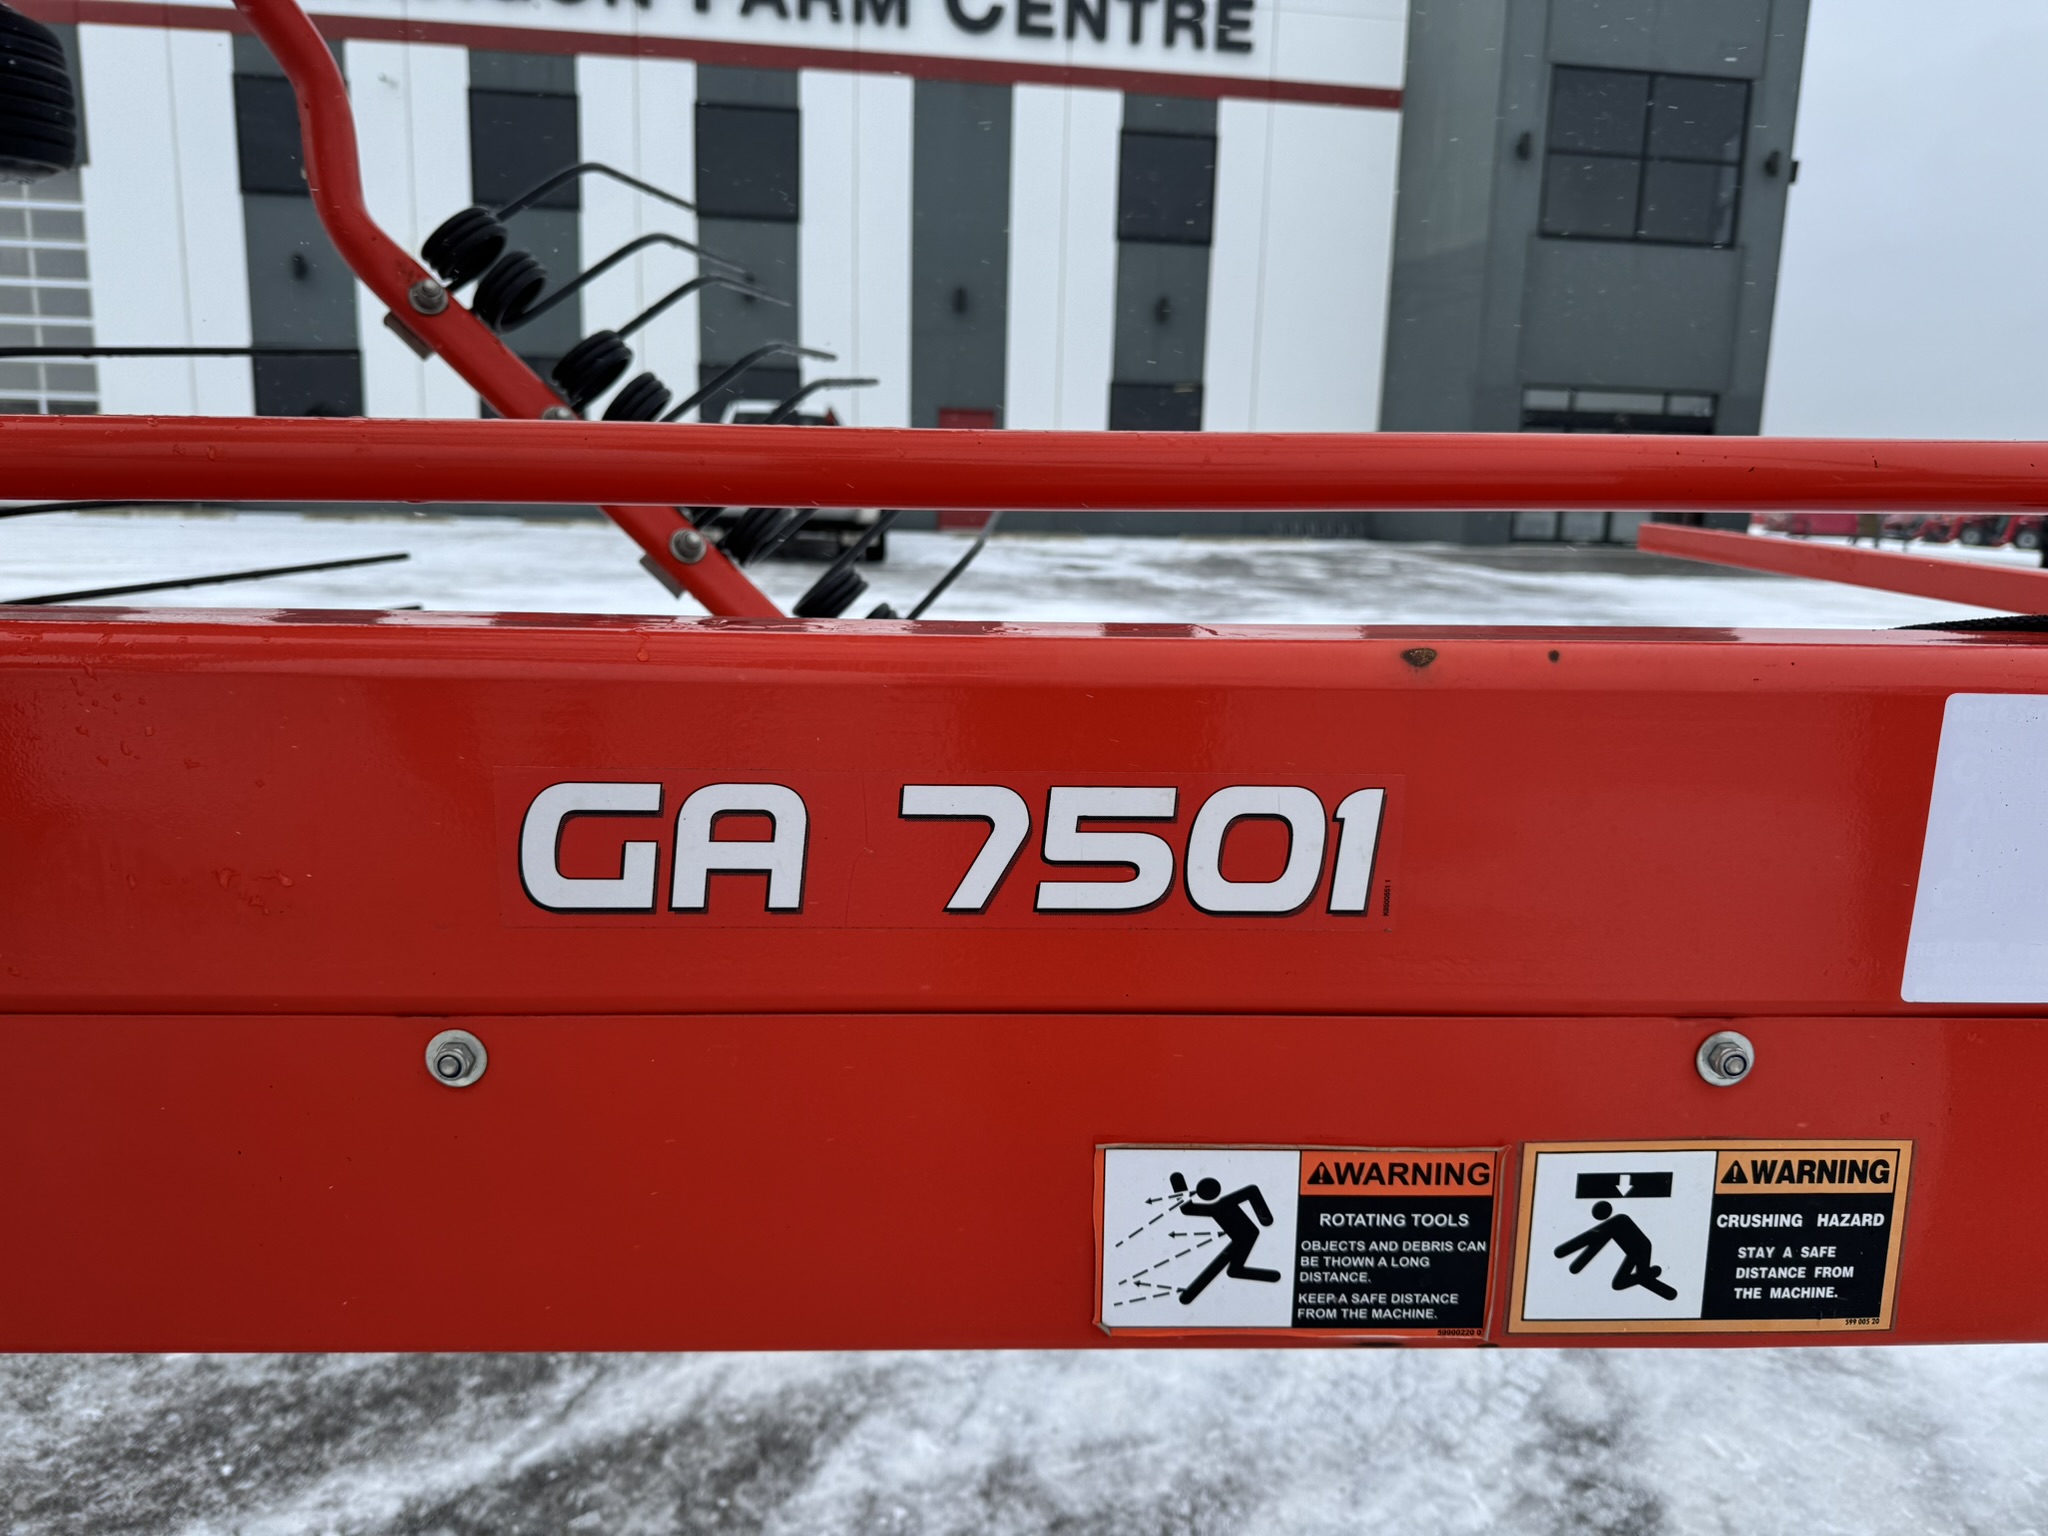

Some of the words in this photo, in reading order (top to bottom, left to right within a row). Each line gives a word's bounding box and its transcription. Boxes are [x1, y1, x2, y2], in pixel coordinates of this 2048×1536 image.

[519, 781, 809, 914] GA
[900, 784, 1388, 917] 7501
[1334, 1162, 1490, 1186] WARNING
[1751, 1159, 1890, 1184] WARNING
[1320, 1213, 1406, 1227] ROTATING
[1411, 1213, 1470, 1227] TOOLS
[1717, 1214, 1803, 1228] CRUSHING
[1817, 1213, 1885, 1227] HAZARD
[1301, 1240, 1366, 1252] OBJECTS
[1369, 1240, 1399, 1252] AND
[1402, 1240, 1454, 1252] DEBRIS
[1457, 1240, 1487, 1252] CAN
[1738, 1246, 1775, 1258] STAY
[1782, 1246, 1792, 1258] A
[1800, 1246, 1837, 1258] SAFE
[1300, 1256, 1319, 1267] BE
[1323, 1256, 1374, 1267] THOWN
[1377, 1256, 1388, 1267] A
[1391, 1256, 1430, 1268] LONG
[1299, 1271, 1371, 1283] DISTANCE.
[1736, 1267, 1806, 1279] DISTANCE
[1814, 1266, 1854, 1278] FROM
[1298, 1293, 1335, 1304] KEEP
[1338, 1293, 1348, 1304] A
[1351, 1293, 1387, 1304] SAFE
[1390, 1293, 1459, 1304] DISTANCE
[1734, 1287, 1762, 1299] THE
[1769, 1286, 1838, 1299] MACHINE.
[1297, 1308, 1337, 1319] FROM
[1341, 1308, 1367, 1319] THE
[1371, 1308, 1438, 1319] MACHINE.
[1845, 1318, 1857, 1326] 599
